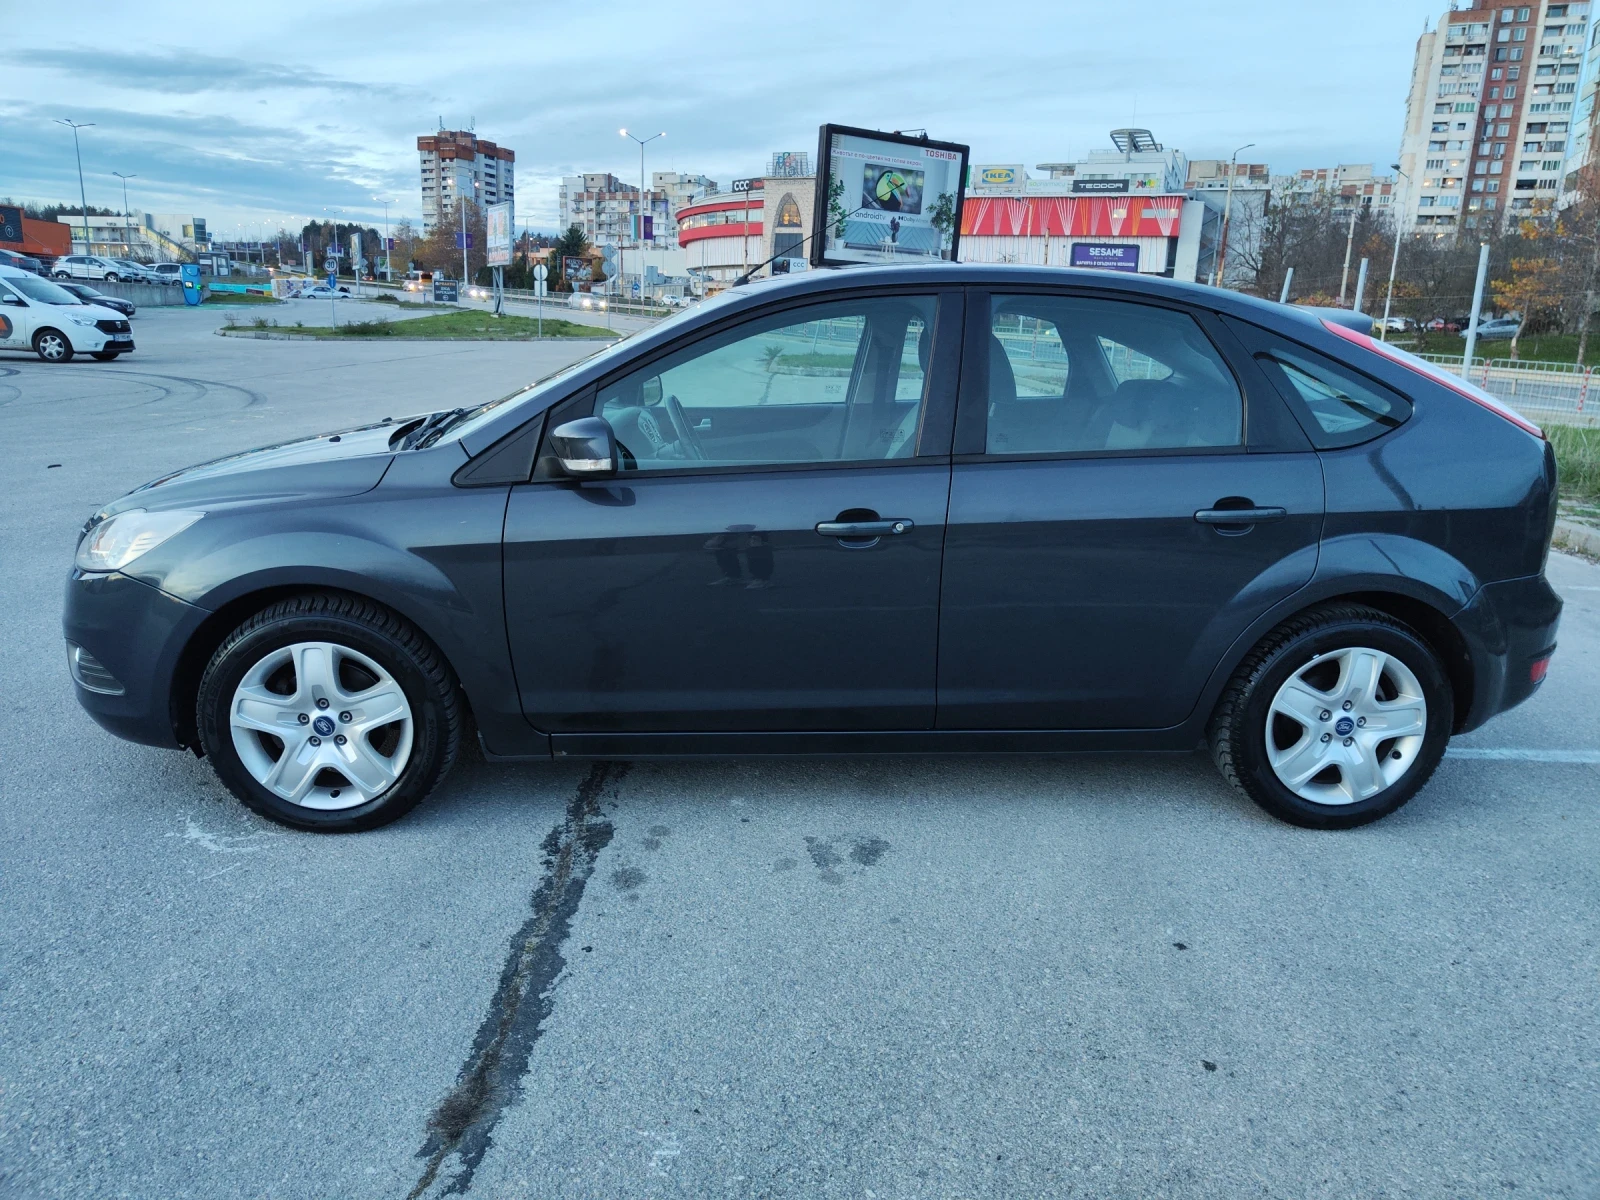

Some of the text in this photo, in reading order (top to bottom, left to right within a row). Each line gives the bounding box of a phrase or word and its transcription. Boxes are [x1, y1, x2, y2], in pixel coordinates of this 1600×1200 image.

[925, 149, 957, 161] TOSHIBA
[734, 180, 750, 191] CCC
[1089, 247, 1124, 257] SESAME
[326, 261, 335, 269] 30
